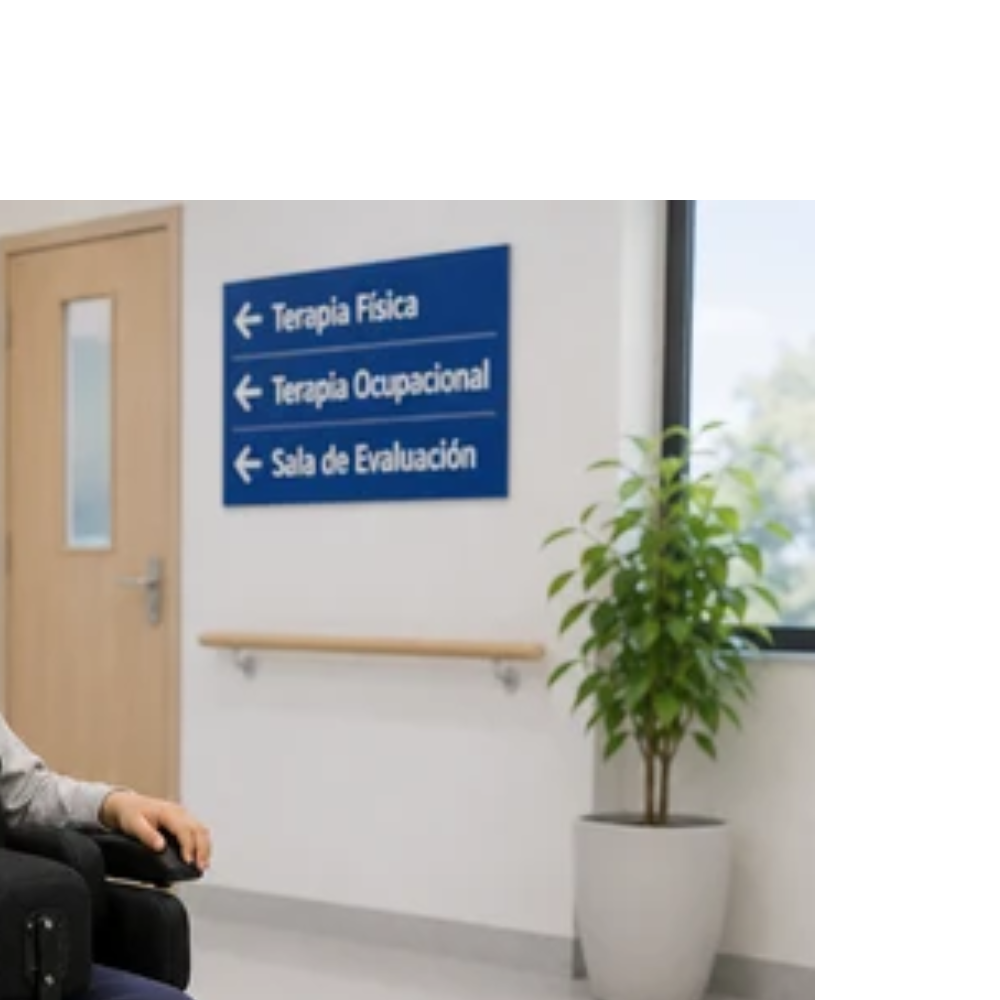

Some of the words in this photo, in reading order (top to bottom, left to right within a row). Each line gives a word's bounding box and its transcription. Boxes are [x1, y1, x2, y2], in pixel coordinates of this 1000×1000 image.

[272, 297, 349, 334] Terapia
[356, 291, 418, 322] Física
[272, 372, 348, 408] Terapia
[354, 359, 489, 402] Ocupacional
[272, 447, 316, 477] Sala
[322, 445, 349, 475] de
[355, 439, 475, 473] Evaluación
